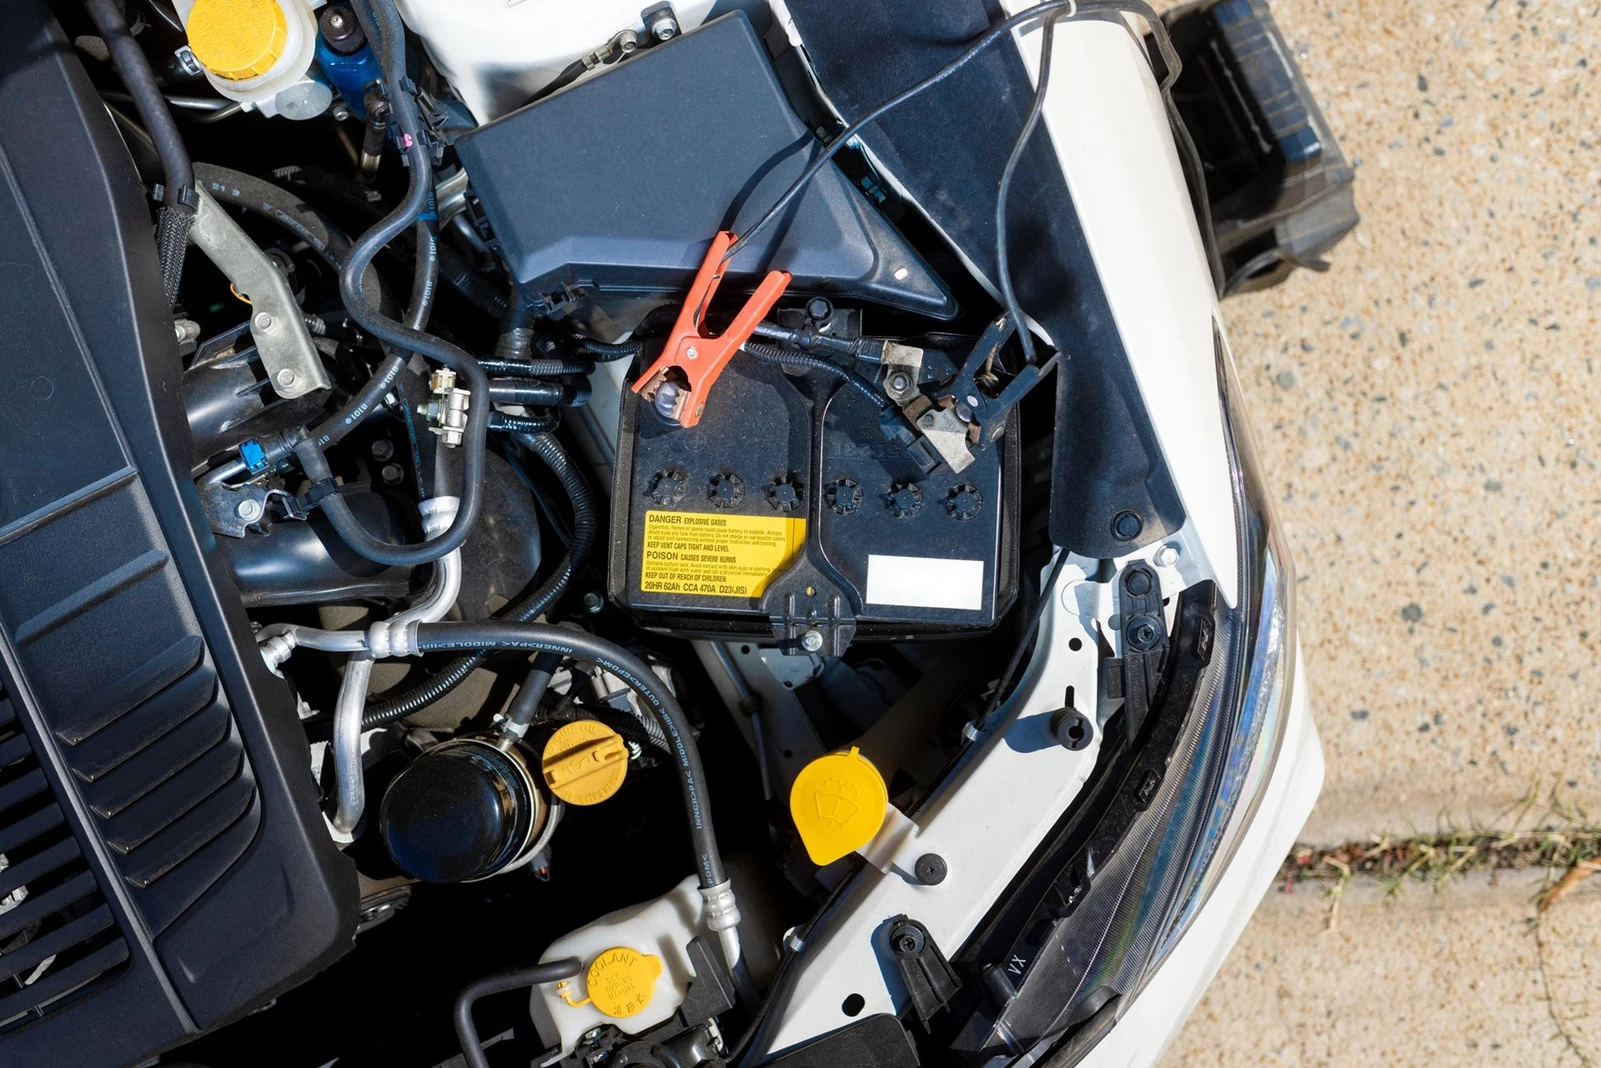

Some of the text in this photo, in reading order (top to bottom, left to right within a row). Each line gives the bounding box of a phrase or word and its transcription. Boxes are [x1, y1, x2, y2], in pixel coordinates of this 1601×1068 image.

[649, 515, 681, 524] DANGER
[647, 551, 678, 560] POISON
[645, 581, 662, 589] 20HR
[683, 583, 698, 592] CCA
[720, 585, 747, 594] D23(JIS)
[587, 952, 639, 988] COOLANT
[605, 972, 621, 983] SEE
